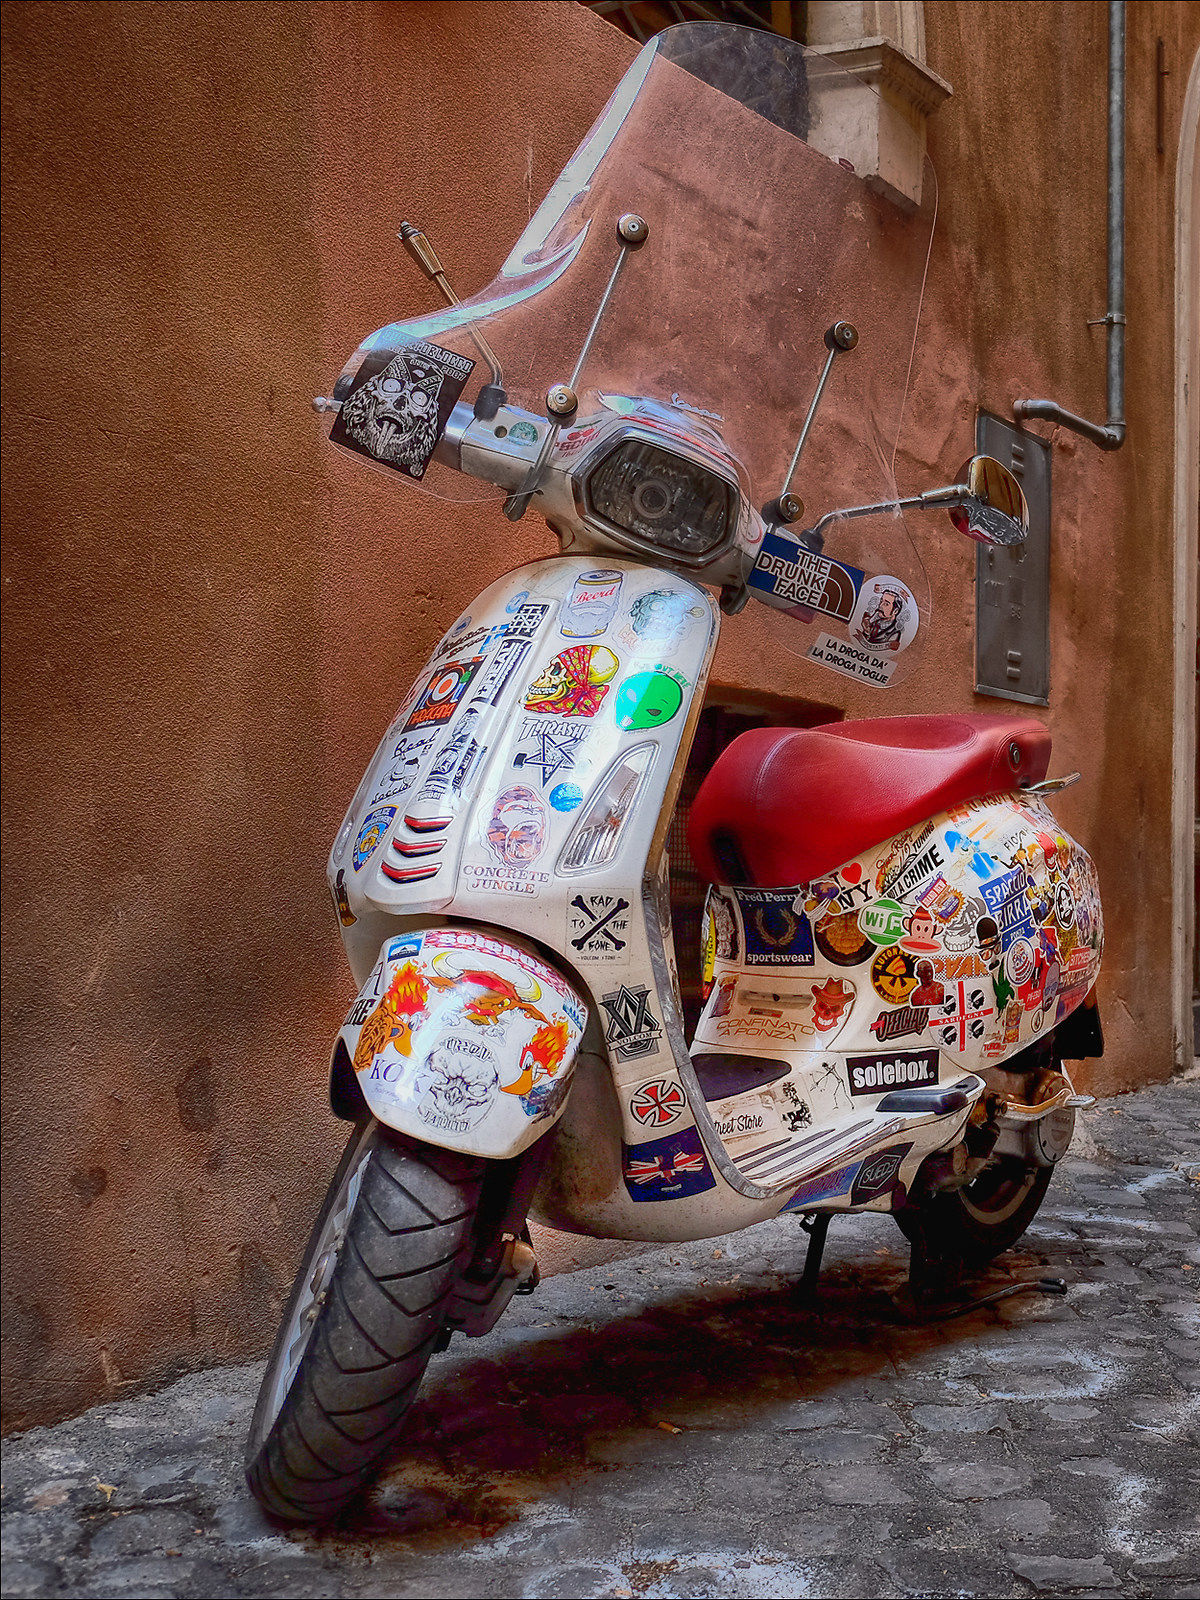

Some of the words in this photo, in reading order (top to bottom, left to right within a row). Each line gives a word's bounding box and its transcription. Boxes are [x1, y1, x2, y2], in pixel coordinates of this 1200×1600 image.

[755, 551, 826, 592] DRUNK
[798, 549, 832, 577] THE
[573, 586, 616, 604] Beerd
[773, 577, 822, 607] FACE
[825, 638, 838, 649] LA
[838, 642, 872, 664] DROGA
[811, 648, 824, 659] LA
[823, 651, 857, 673] DROGA
[857, 664, 889, 684] TOGLIE
[912, 820, 935, 853] TUNING
[462, 865, 550, 883] CONCRETE
[898, 882, 905, 895] A
[902, 844, 945, 889] CRIME
[472, 878, 535, 892] JUNGLE
[831, 871, 846, 891] I
[590, 894, 614, 907] RAD
[736, 890, 763, 902] Fred
[839, 879, 874, 911] NY
[995, 892, 1031, 931] BIRRA
[572, 919, 585, 929] TO
[612, 920, 629, 930] THE
[746, 952, 812, 964] sportswear
[716, 1018, 816, 1035] CONFINATO
[938, 1011, 985, 1025] SARDEGNA
[616, 1031, 652, 1046] VOLCOM
[719, 1029, 730, 1037] A
[734, 1027, 796, 1042] PONZA
[713, 1117, 736, 1135] treet
[736, 1114, 764, 1132] Store
